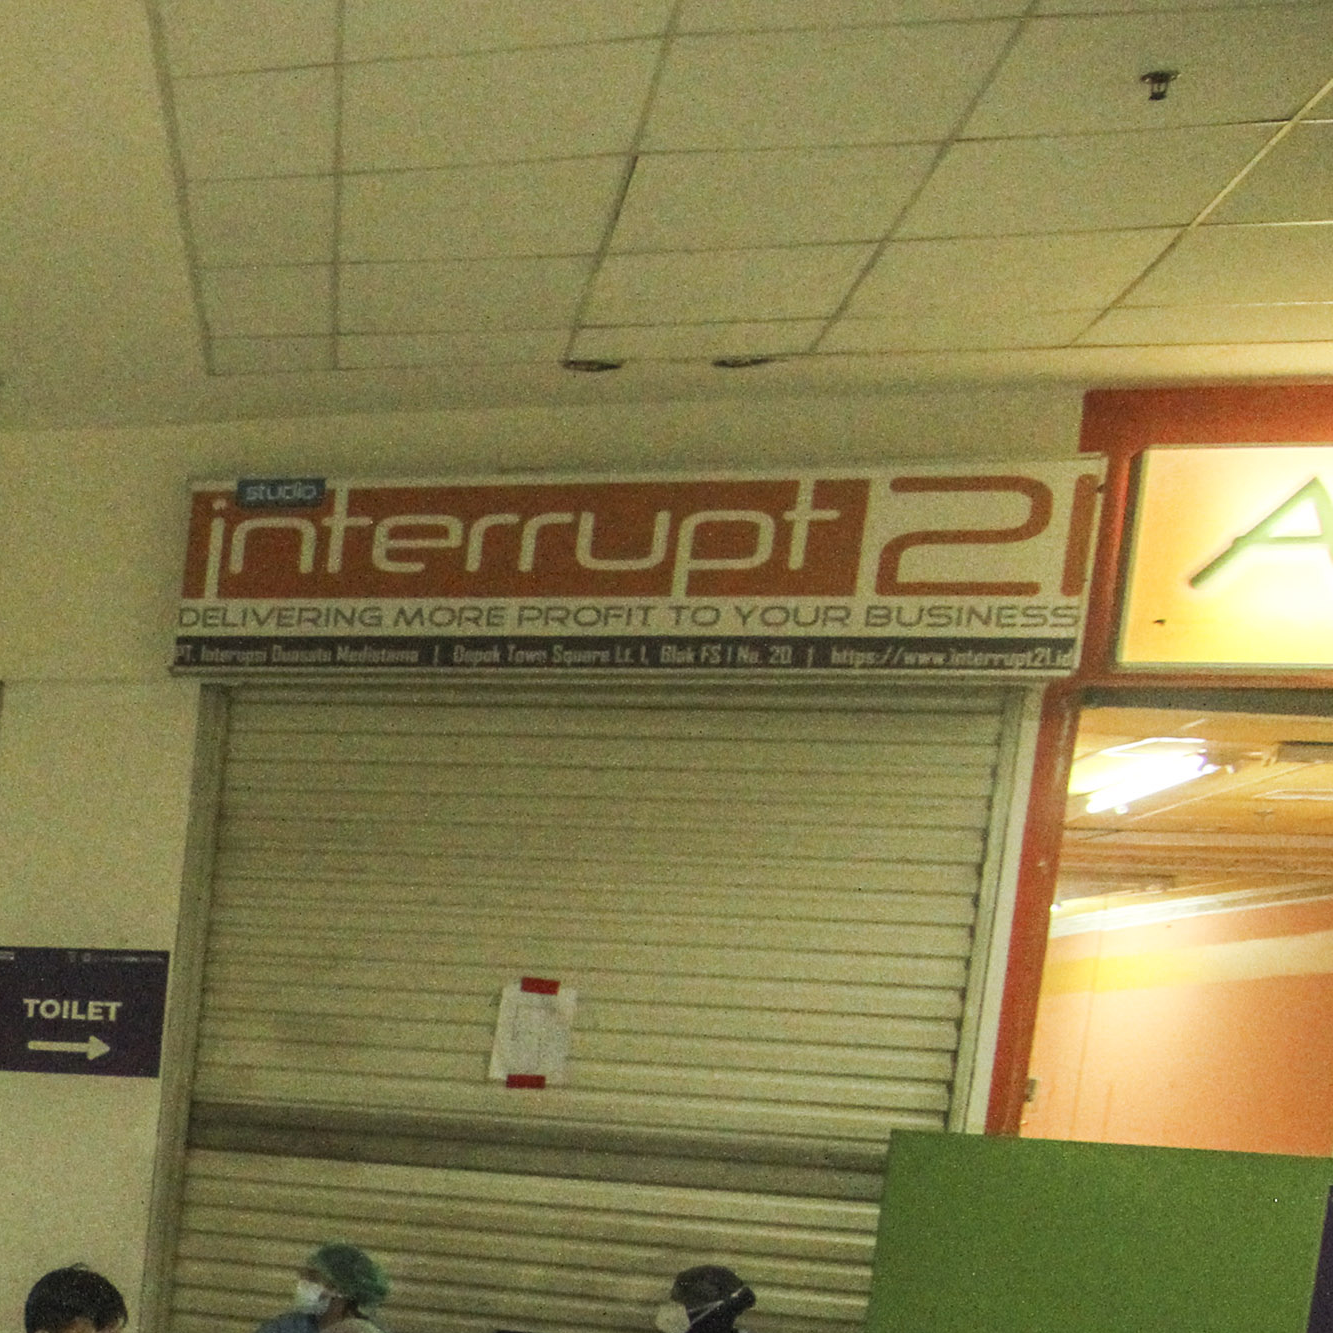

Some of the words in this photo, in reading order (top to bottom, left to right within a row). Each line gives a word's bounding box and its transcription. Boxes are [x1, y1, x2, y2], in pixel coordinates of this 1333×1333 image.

[246, 482, 317, 501] studio
[178, 606, 383, 630] DELIVERING
[391, 605, 506, 628] MORE
[516, 605, 662, 628] PROFIT
[670, 605, 721, 629] TO
[733, 605, 853, 630] YOUR
[864, 604, 1082, 630] BUSINESS
[23, 998, 123, 1022] TOILET
